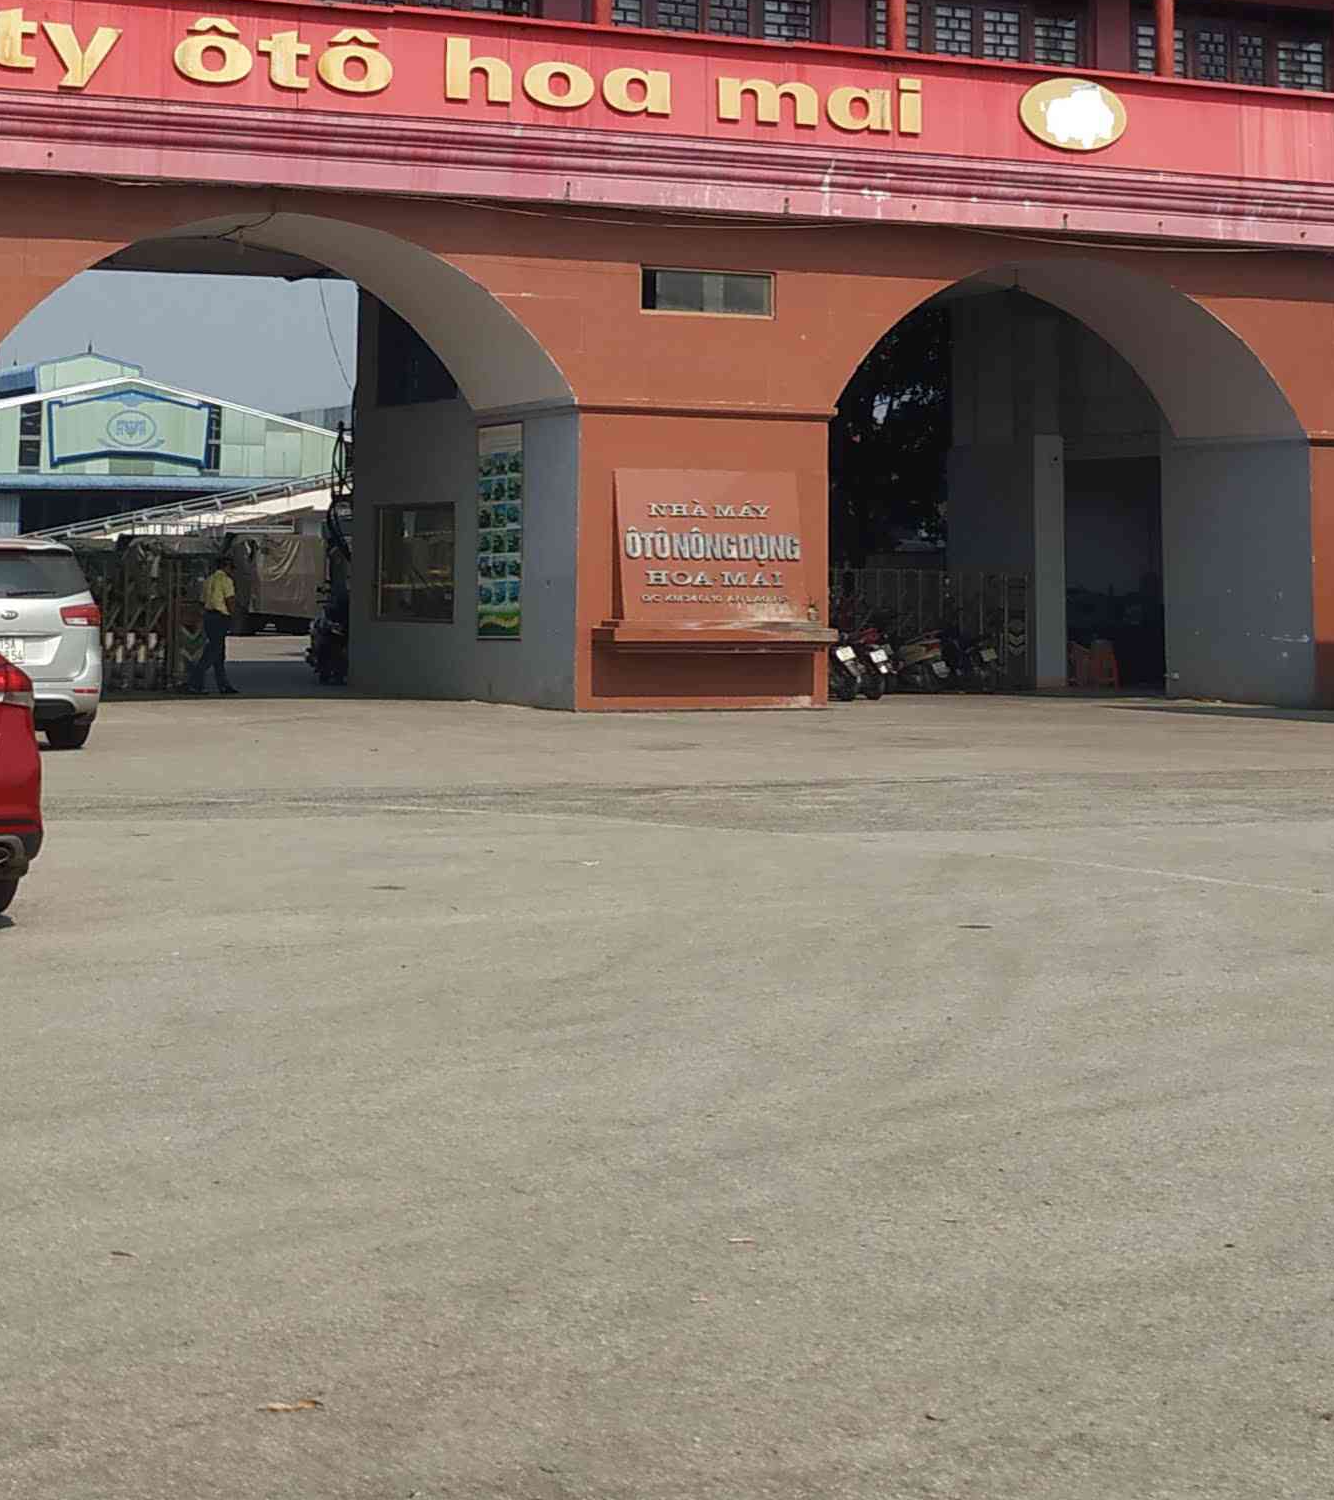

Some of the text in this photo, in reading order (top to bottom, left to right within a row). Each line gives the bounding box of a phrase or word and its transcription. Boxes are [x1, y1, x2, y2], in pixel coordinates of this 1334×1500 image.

[173, 17, 394, 95] ôtô
[444, 37, 673, 115] hoa
[716, 76, 923, 136] mai
[648, 500, 770, 520] NHÀ MÁY
[645, 570, 784, 589] HOA MAI
